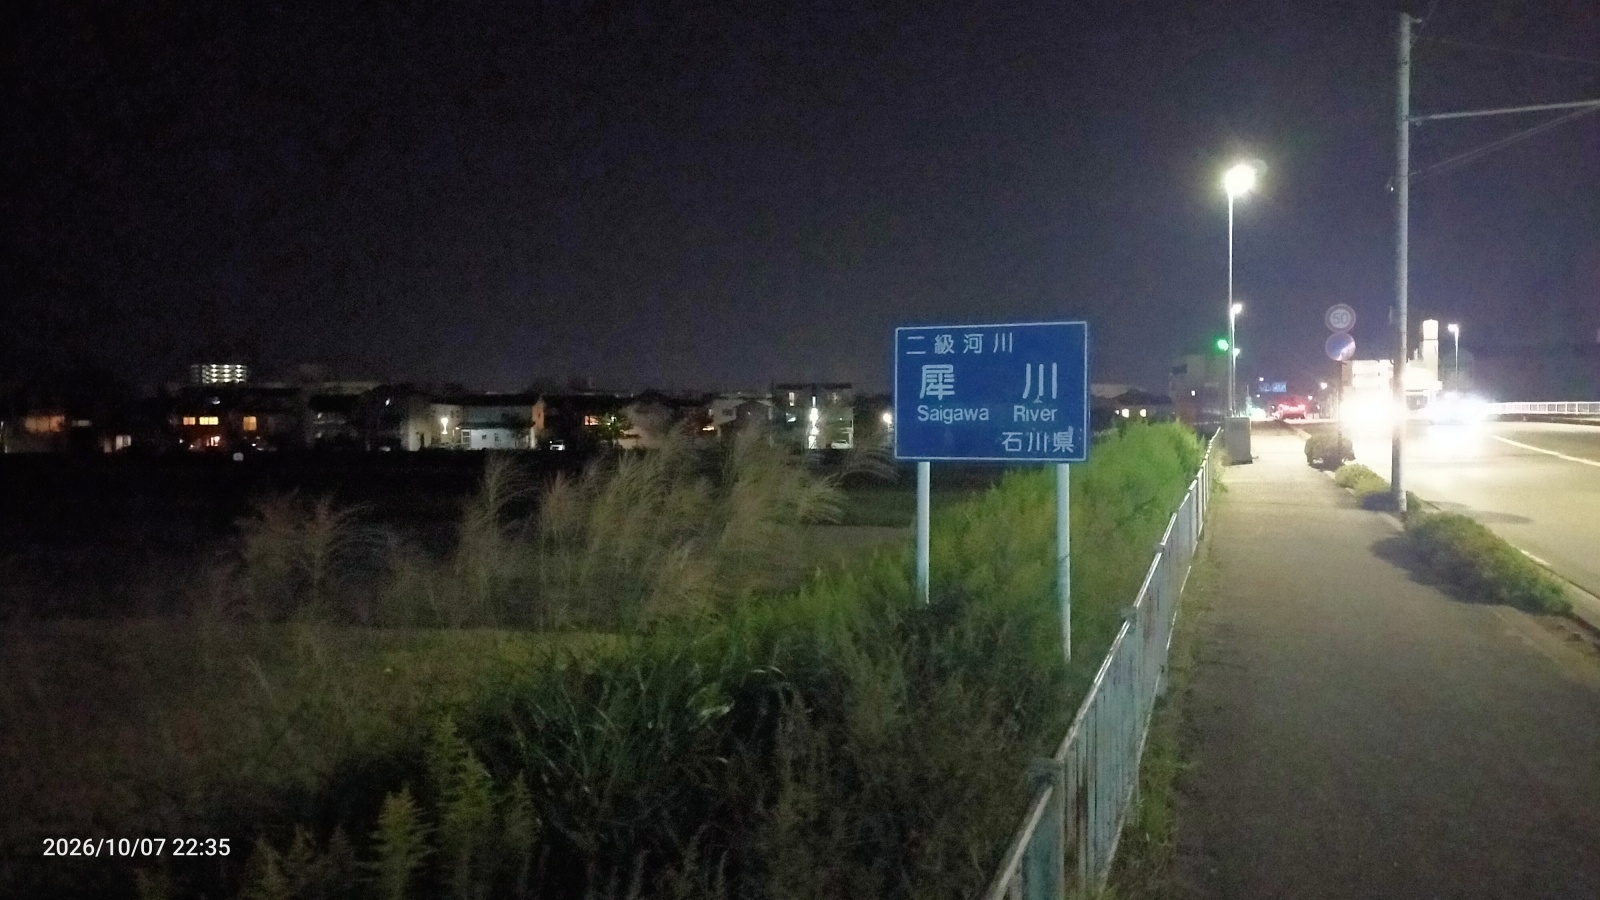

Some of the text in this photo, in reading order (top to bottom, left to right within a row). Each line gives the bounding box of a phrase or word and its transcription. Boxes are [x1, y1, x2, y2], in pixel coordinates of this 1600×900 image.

[1332, 311, 1349, 325] 50
[906, 332, 1012, 354] 二級河川
[917, 405, 1057, 424] Saigawa River
[1002, 430, 1074, 453] 石川県
